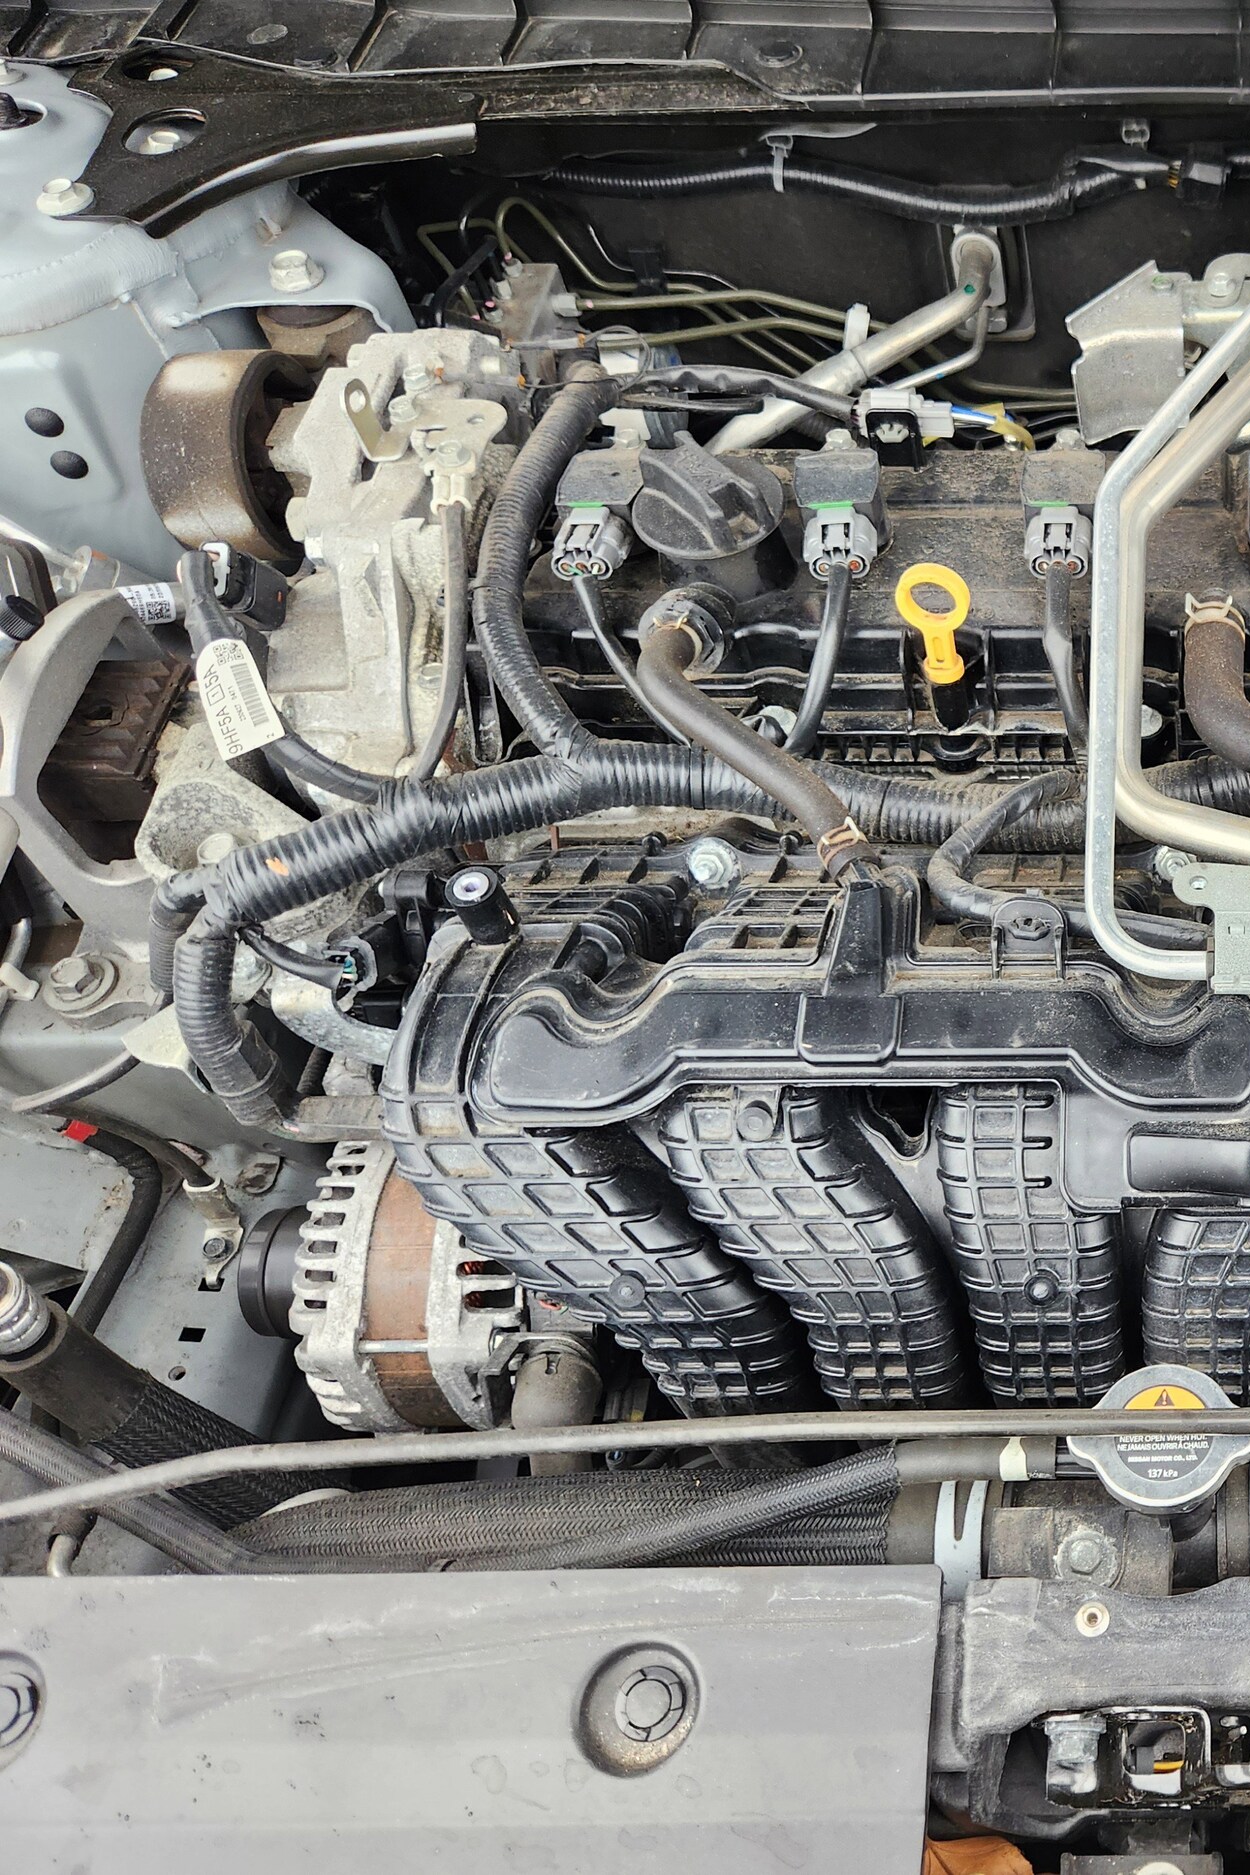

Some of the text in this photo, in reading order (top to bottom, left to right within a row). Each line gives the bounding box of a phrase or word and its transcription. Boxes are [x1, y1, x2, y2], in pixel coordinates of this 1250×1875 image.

[203, 664, 219, 689] 5A
[216, 705, 243, 754] 9HF5A
[1119, 1435, 1143, 1443] NEVER
[1144, 1434, 1166, 1442] OPEN
[1166, 1434, 1190, 1442] WHEN
[1117, 1443, 1128, 1451] NE
[1128, 1443, 1151, 1451] JAMAIS
[1151, 1442, 1178, 1450] OUVRIR
[1147, 1469, 1178, 1478] 137 kPa
